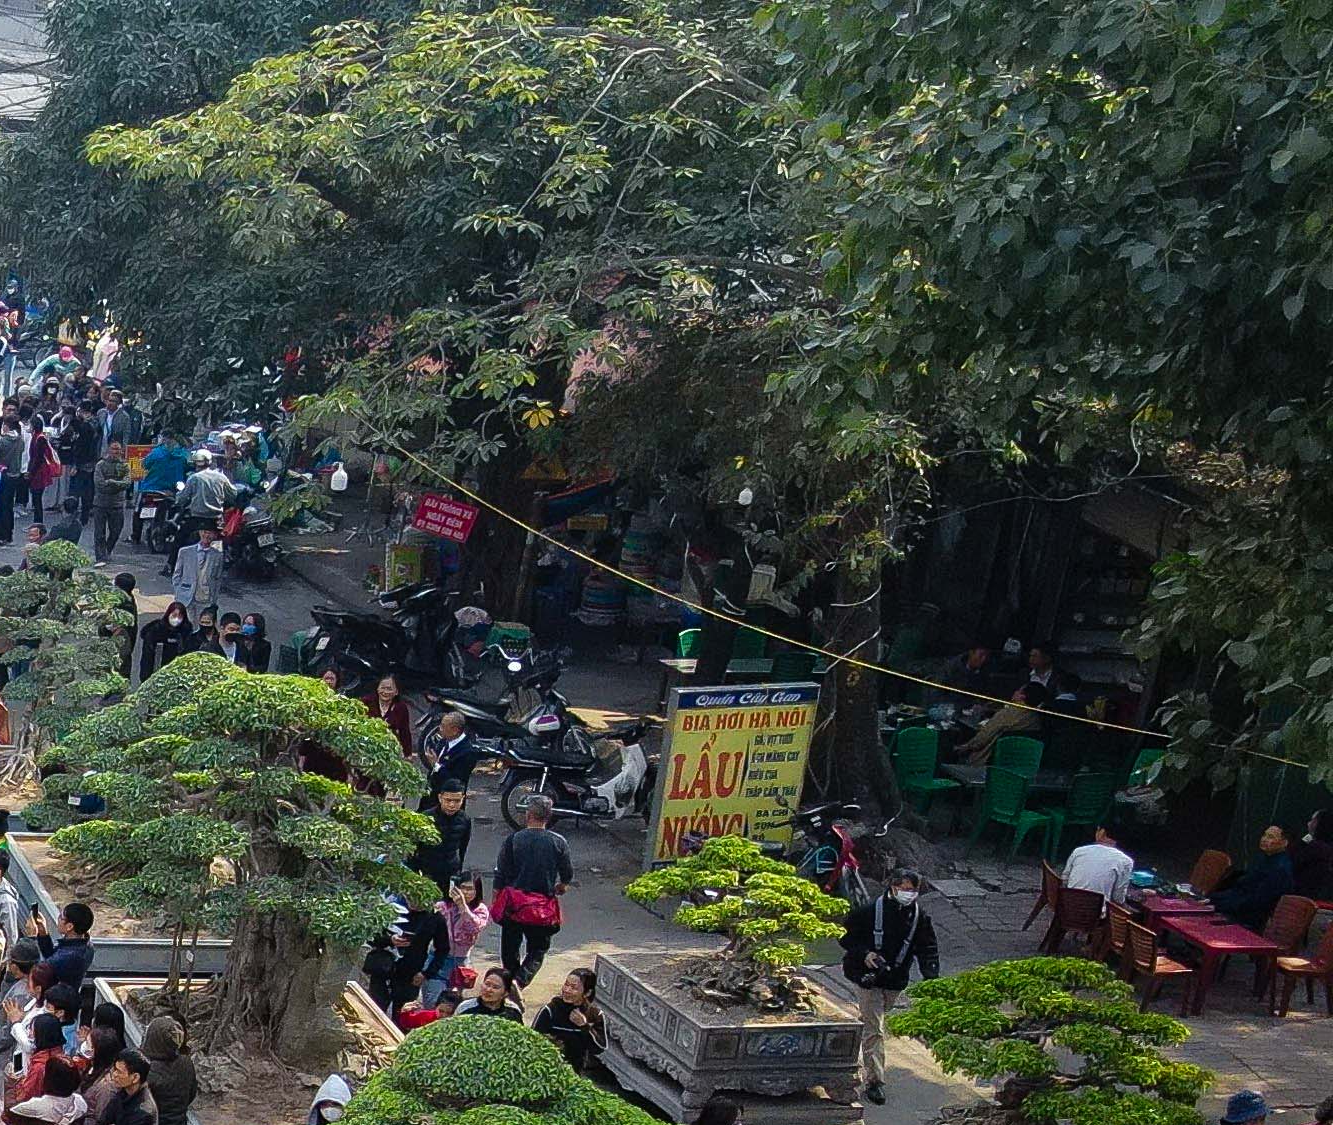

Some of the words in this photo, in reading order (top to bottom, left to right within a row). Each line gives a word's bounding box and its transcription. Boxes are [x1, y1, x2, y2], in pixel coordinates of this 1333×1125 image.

[682, 714, 711, 731] BIA
[715, 711, 746, 730] HƠI
[749, 708, 771, 728] HÀ
[666, 732, 745, 801] LẨU
